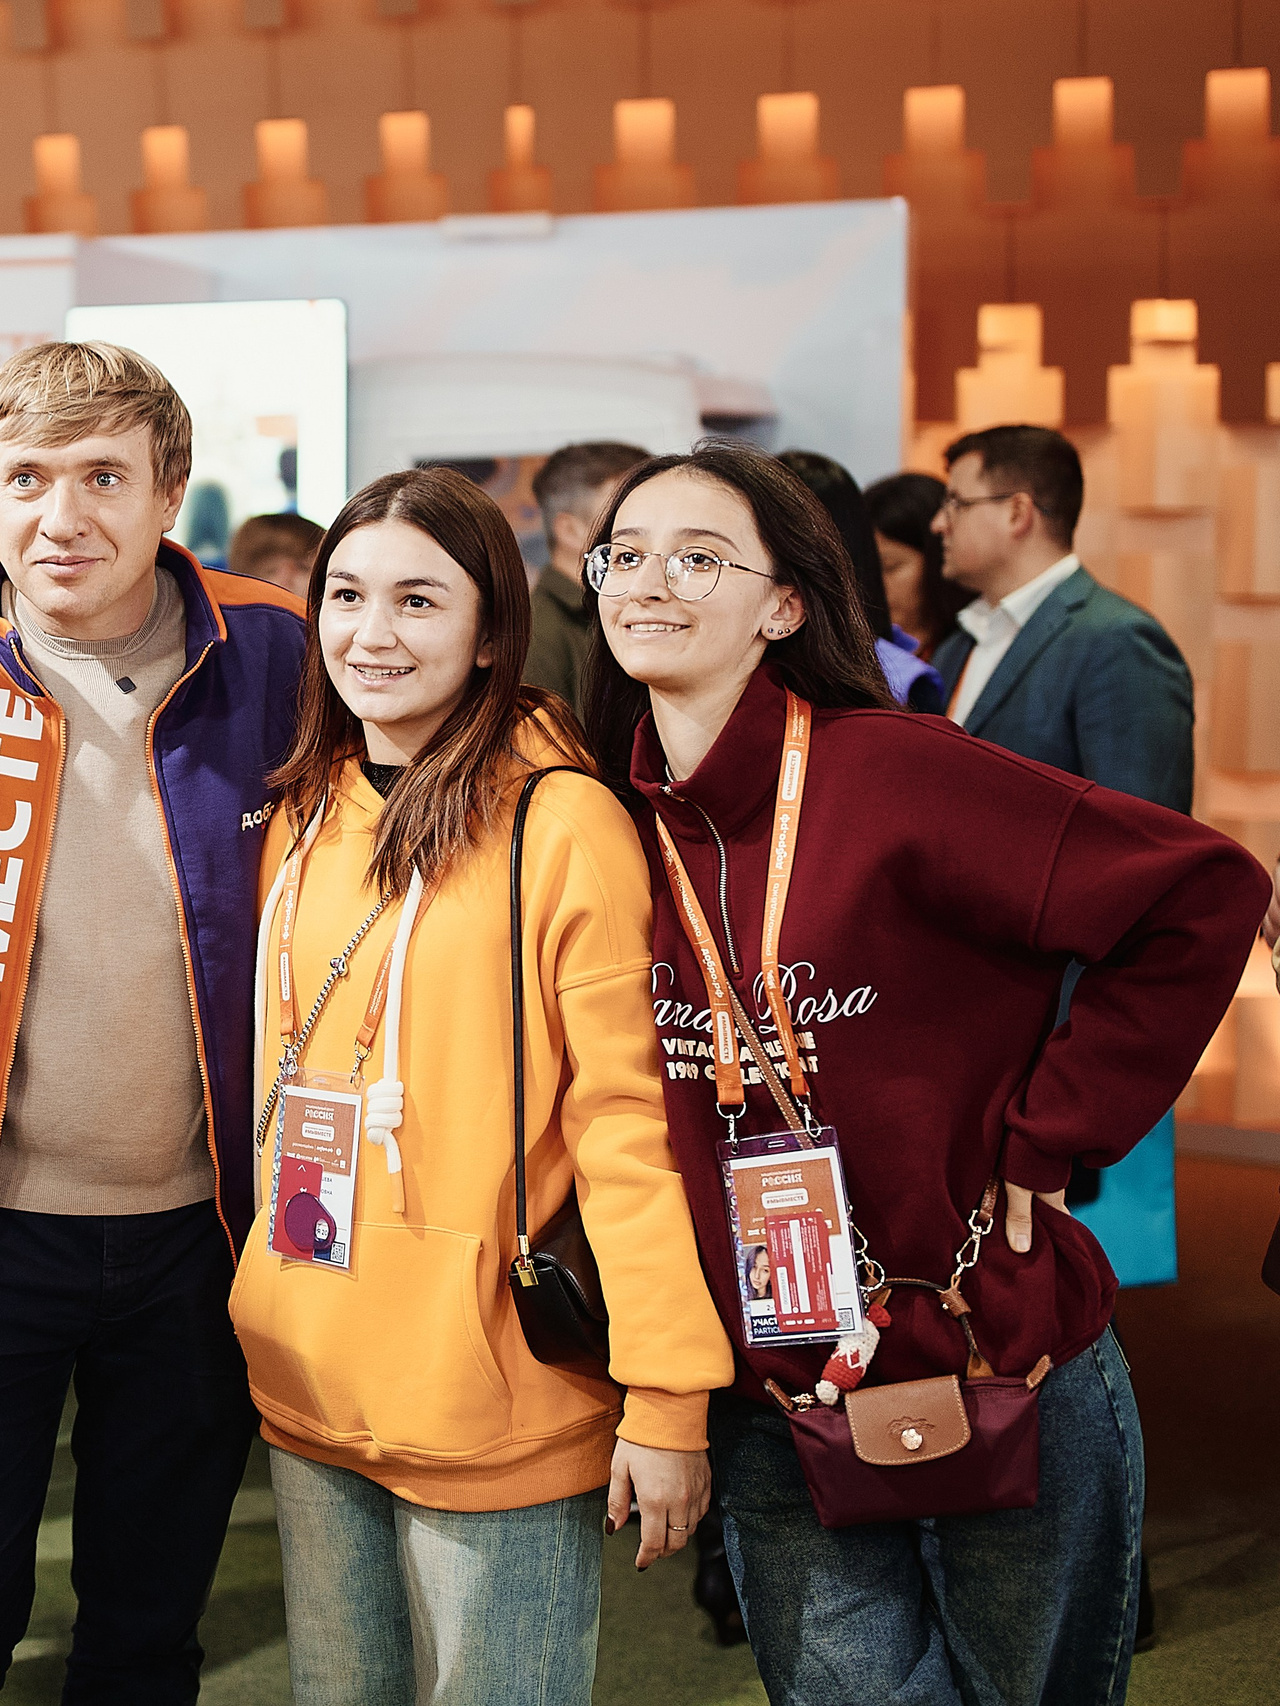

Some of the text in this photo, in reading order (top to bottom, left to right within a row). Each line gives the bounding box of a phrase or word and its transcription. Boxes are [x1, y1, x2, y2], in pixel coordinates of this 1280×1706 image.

[775, 813, 791, 870] добро.рф
[700, 947, 725, 998] добро.рф
[305, 1108, 334, 1121] РОССИЯ
[761, 1173, 803, 1187] РОССИЯ
